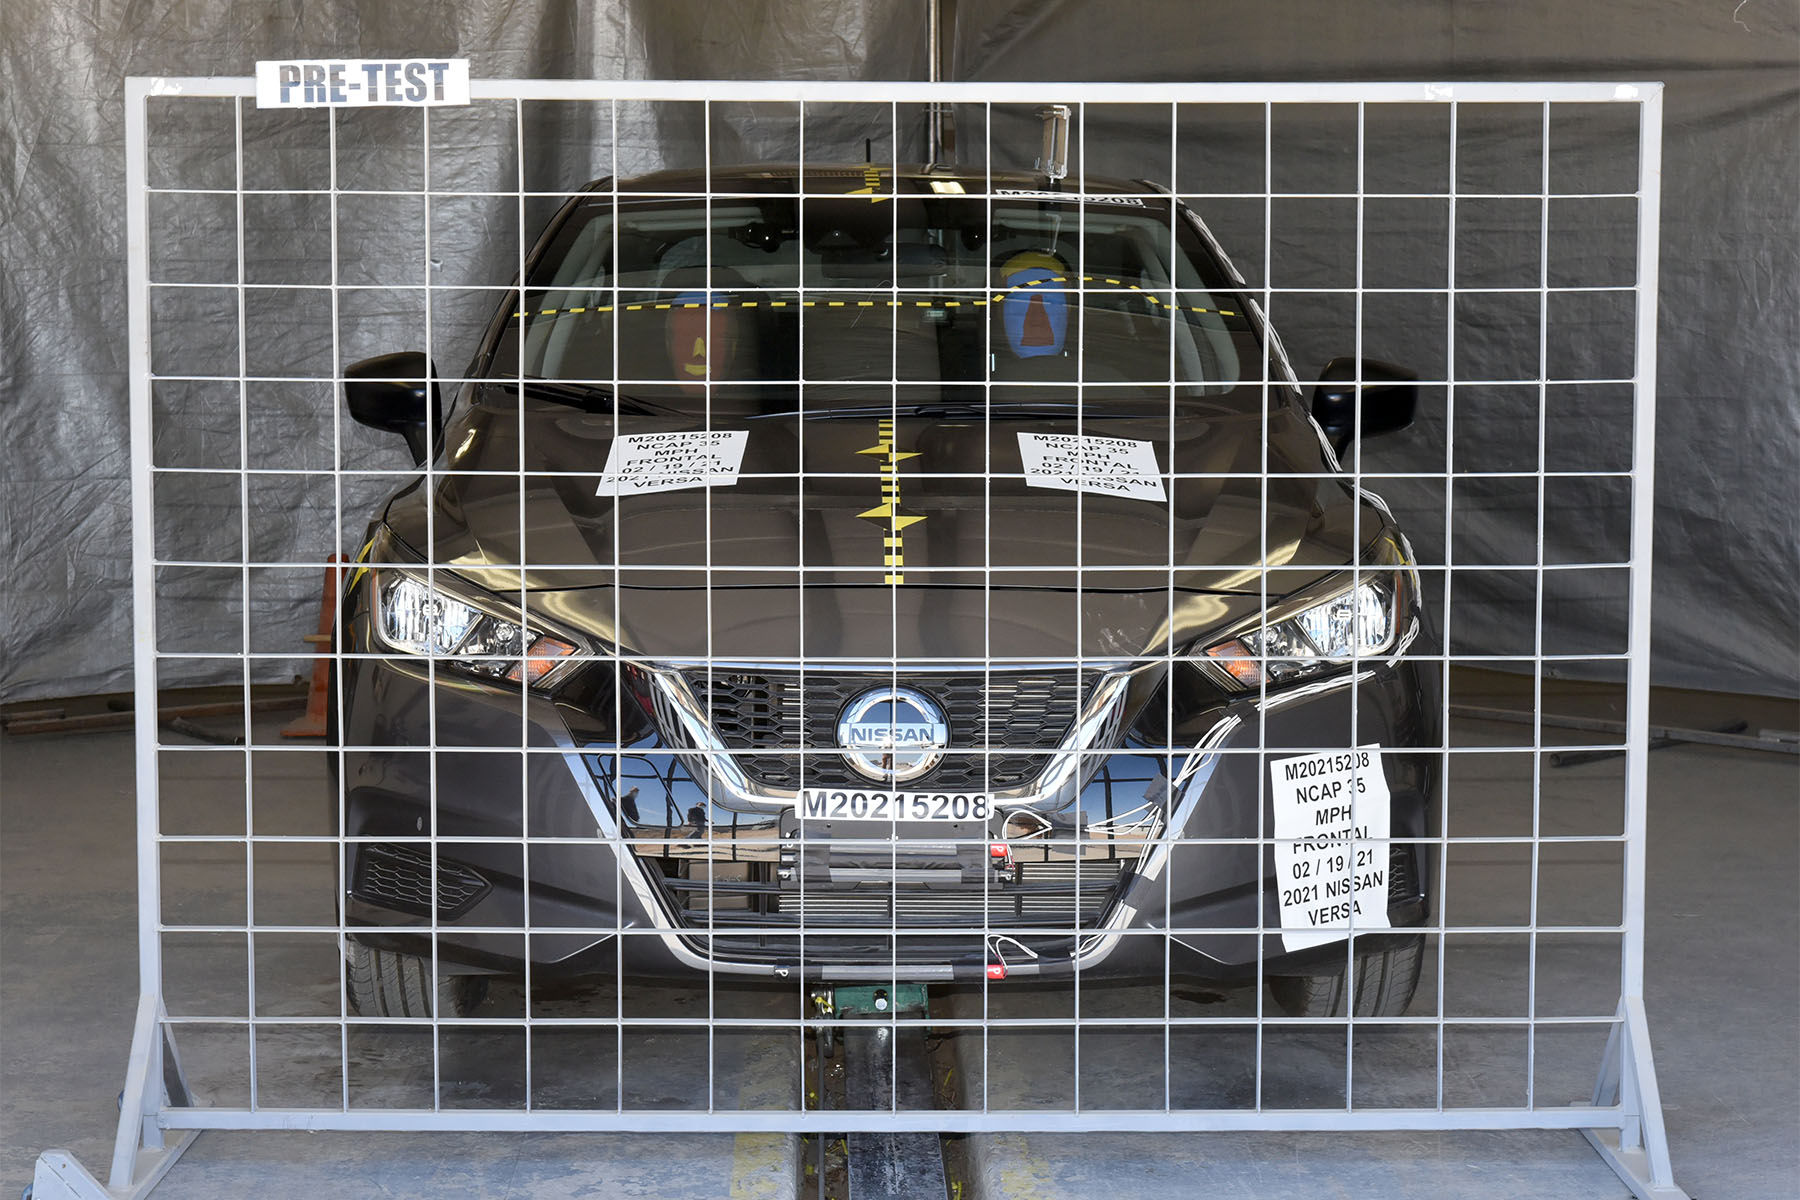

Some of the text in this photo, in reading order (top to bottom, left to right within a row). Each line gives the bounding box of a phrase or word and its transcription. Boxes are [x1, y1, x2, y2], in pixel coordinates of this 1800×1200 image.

[279, 62, 449, 103] PRE-TEST
[628, 433, 732, 443] M20215208
[1034, 435, 1137, 448] M20215208
[637, 441, 692, 450] NCAP
[655, 448, 697, 456] MPH
[1046, 443, 1129, 455] NCAP 35
[627, 454, 722, 466] FRONTAL
[1067, 450, 1110, 459] MPH
[1043, 456, 1138, 470] FRONTAL
[607, 474, 648, 483] 202
[634, 476, 703, 487] VERSA
[1060, 477, 1130, 491] VERSA
[1082, 473, 1157, 487] SSAN
[851, 727, 934, 742] NISSAN
[1296, 777, 1366, 804] NCAP 35
[803, 789, 989, 820] M20215208
[1315, 804, 1352, 826] MPH
[1293, 825, 1373, 854] FRONTAL
[1292, 861, 1310, 879] 02
[1316, 858, 1321, 876] /
[1326, 855, 1344, 873] 19
[1357, 848, 1373, 867] 21
[1283, 870, 1383, 907] 2021 NISSAN
[1308, 900, 1362, 926] VERSA
